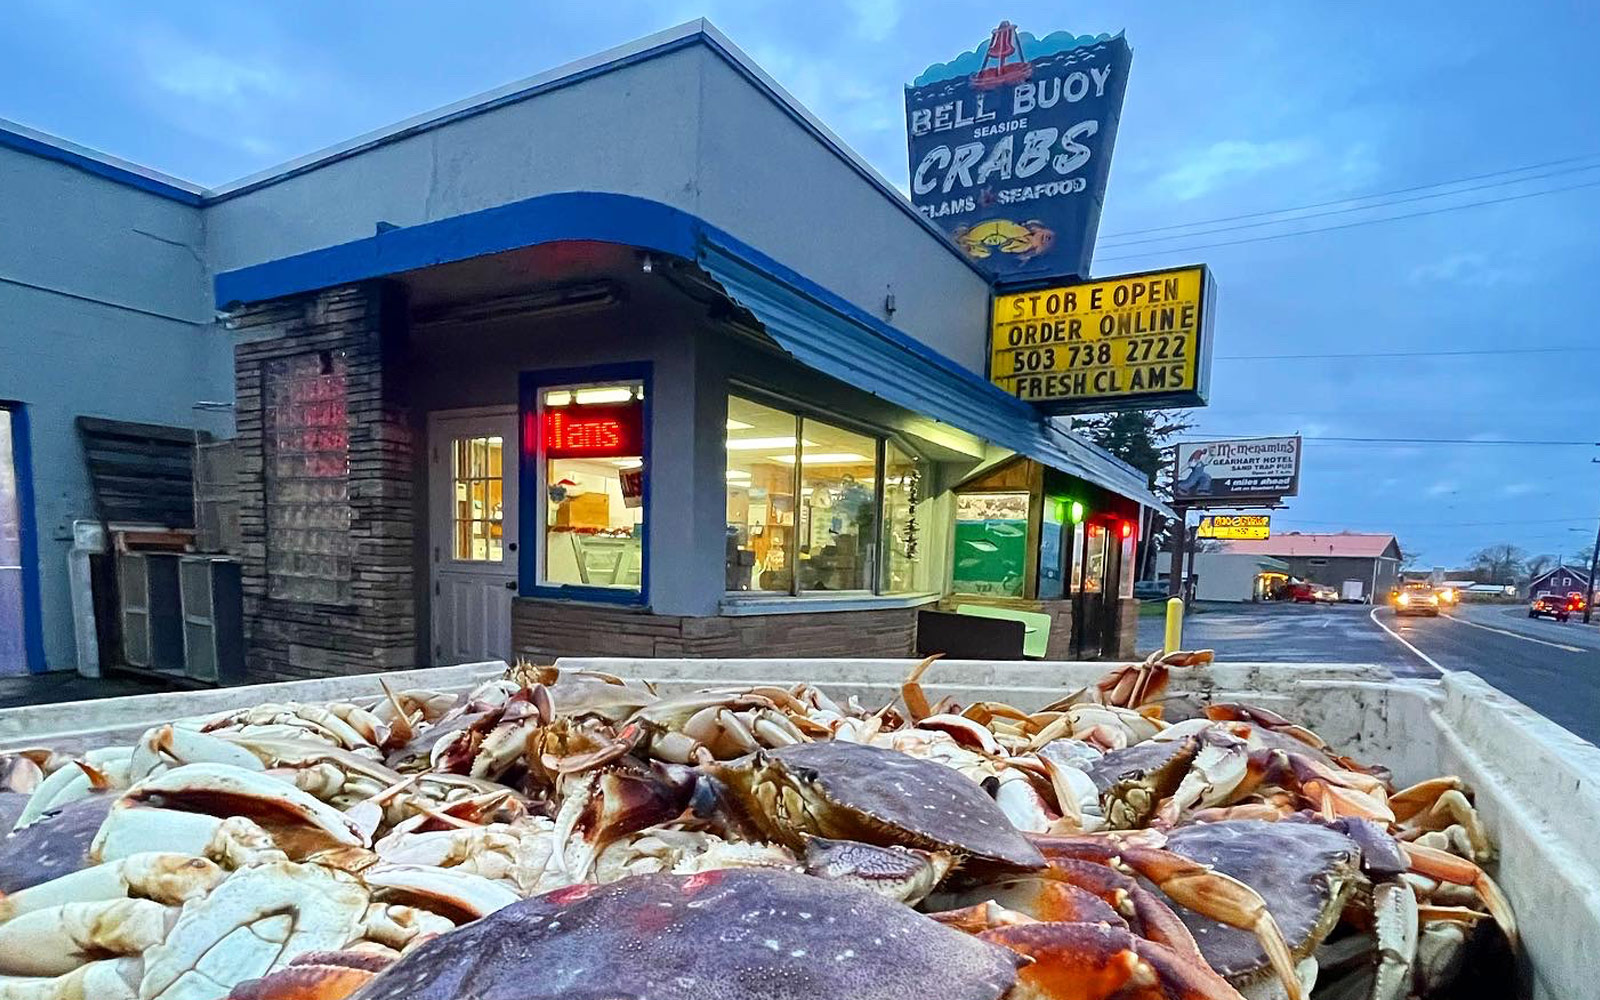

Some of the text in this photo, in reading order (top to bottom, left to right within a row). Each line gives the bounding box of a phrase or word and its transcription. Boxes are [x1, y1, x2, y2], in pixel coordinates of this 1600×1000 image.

[911, 64, 1112, 136] BELL BUOY
[973, 118, 1028, 139] SEASIDE
[914, 120, 1098, 195] CRABS
[998, 177, 1087, 204] SEAFOOD
[1113, 278, 1179, 306] OPEN
[1008, 305, 1195, 346] ORDER ONLINE
[1013, 335, 1186, 373] 503 738 2722
[1016, 374, 1087, 400] FRESH
[1213, 458, 1260, 466] GEARHART
[1233, 478, 1258, 486] miles
[1260, 477, 1291, 485] ahead
